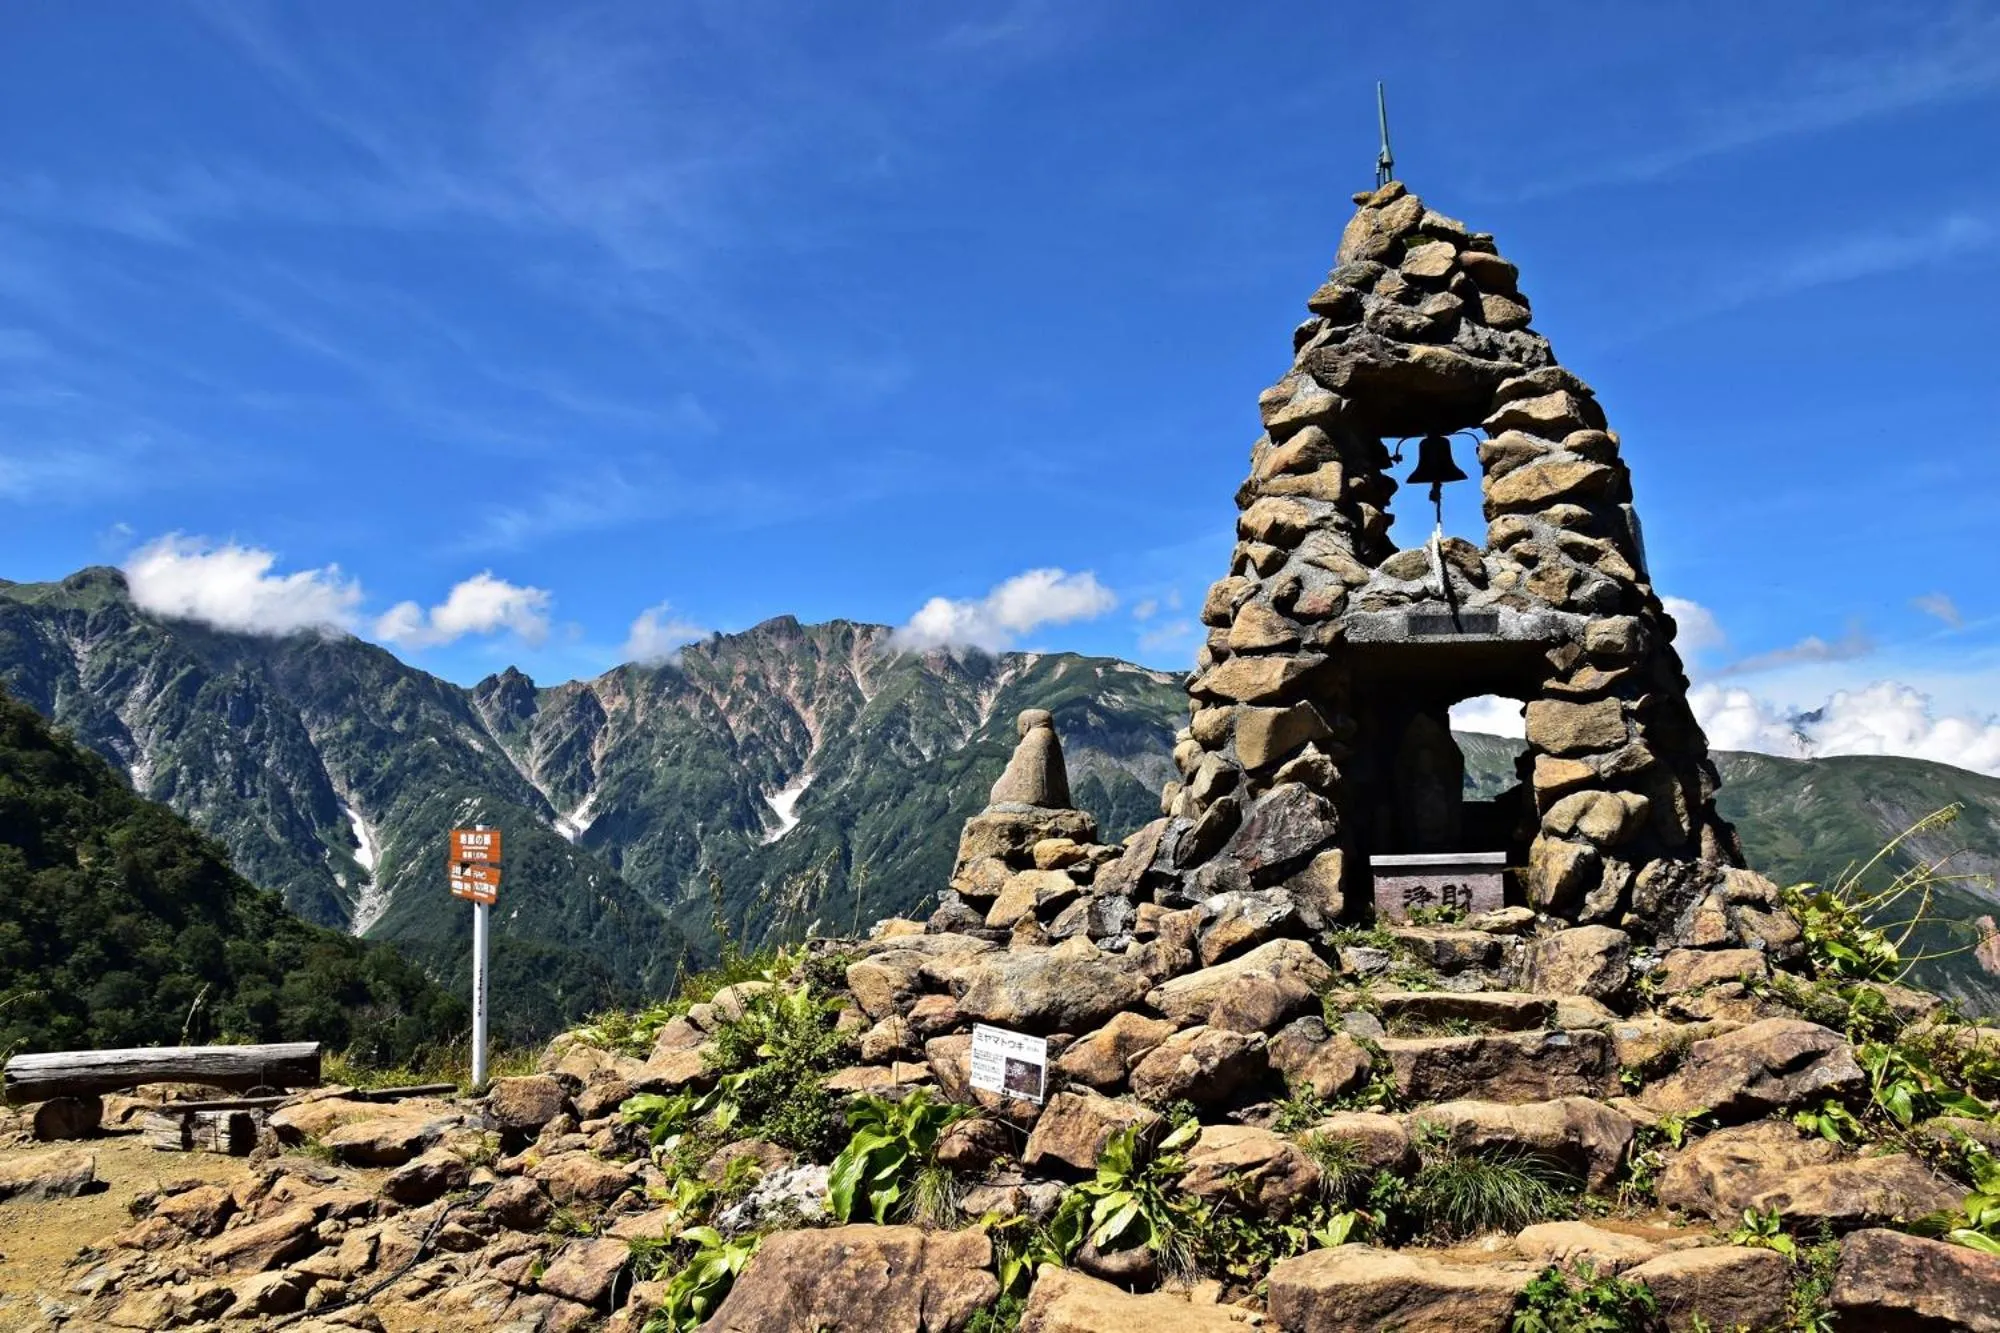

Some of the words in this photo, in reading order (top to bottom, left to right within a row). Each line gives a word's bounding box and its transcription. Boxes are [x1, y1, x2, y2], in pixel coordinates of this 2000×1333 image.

[975, 1031, 1025, 1052] ミヤマトウキ
